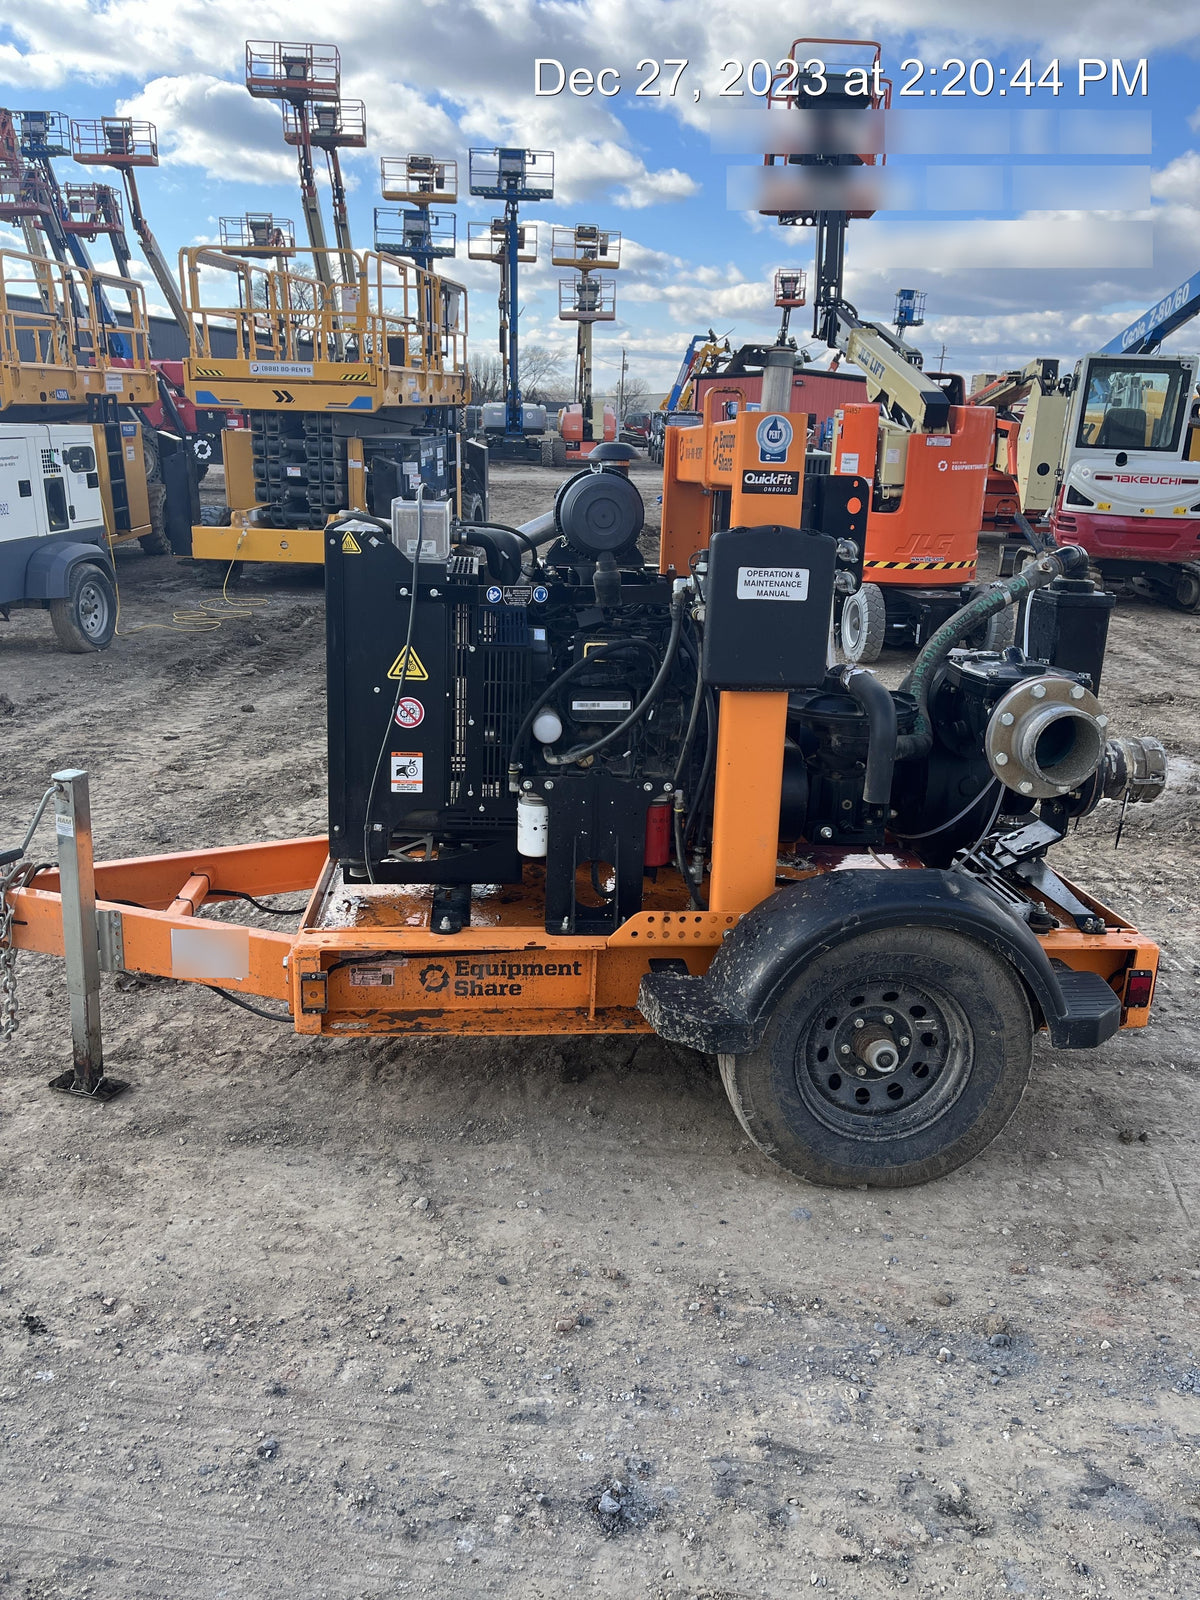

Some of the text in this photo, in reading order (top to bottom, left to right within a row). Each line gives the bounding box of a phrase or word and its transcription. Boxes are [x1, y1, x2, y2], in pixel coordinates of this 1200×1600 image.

[869, 357, 886, 380] LIFT
[744, 472, 793, 485] QuickFit
[894, 533, 956, 556] JLG
[746, 569, 801, 579] OPERATION &
[743, 579, 802, 589] MAINTENANCE
[756, 589, 790, 598] MANUAL
[454, 959, 583, 980] Equipment
[454, 980, 522, 997] Share
